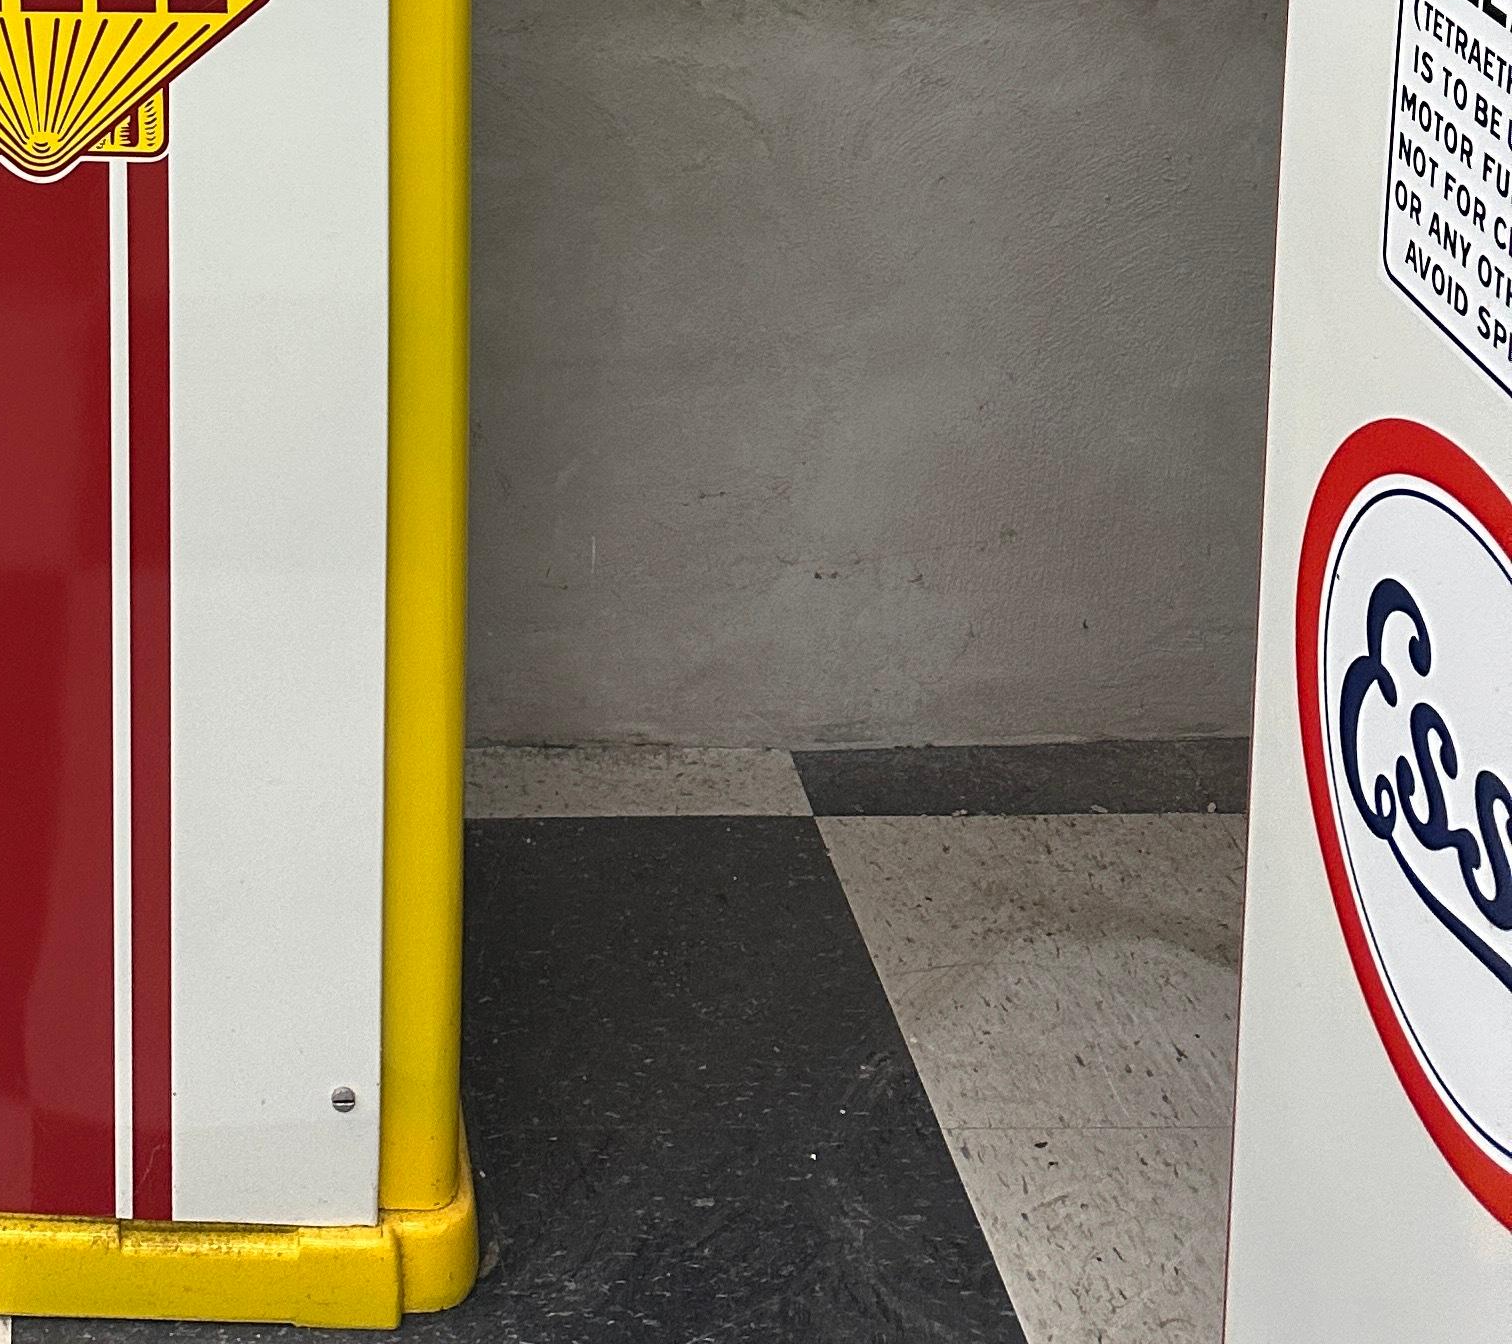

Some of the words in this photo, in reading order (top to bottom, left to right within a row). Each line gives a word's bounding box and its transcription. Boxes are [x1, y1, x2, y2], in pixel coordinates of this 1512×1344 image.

[1414, 45, 1433, 84] IS
[1443, 66, 1467, 110] TO
[1474, 93, 1503, 140] BE
[1399, 132, 1439, 188] NOT
[1444, 171, 1485, 233] FOR
[1401, 85, 1474, 169] MOTOR
[1482, 152, 1512, 198] FU
[1395, 180, 1422, 226] OR
[1428, 212, 1472, 268] ANY
[1405, 239, 1468, 317] AVOID
